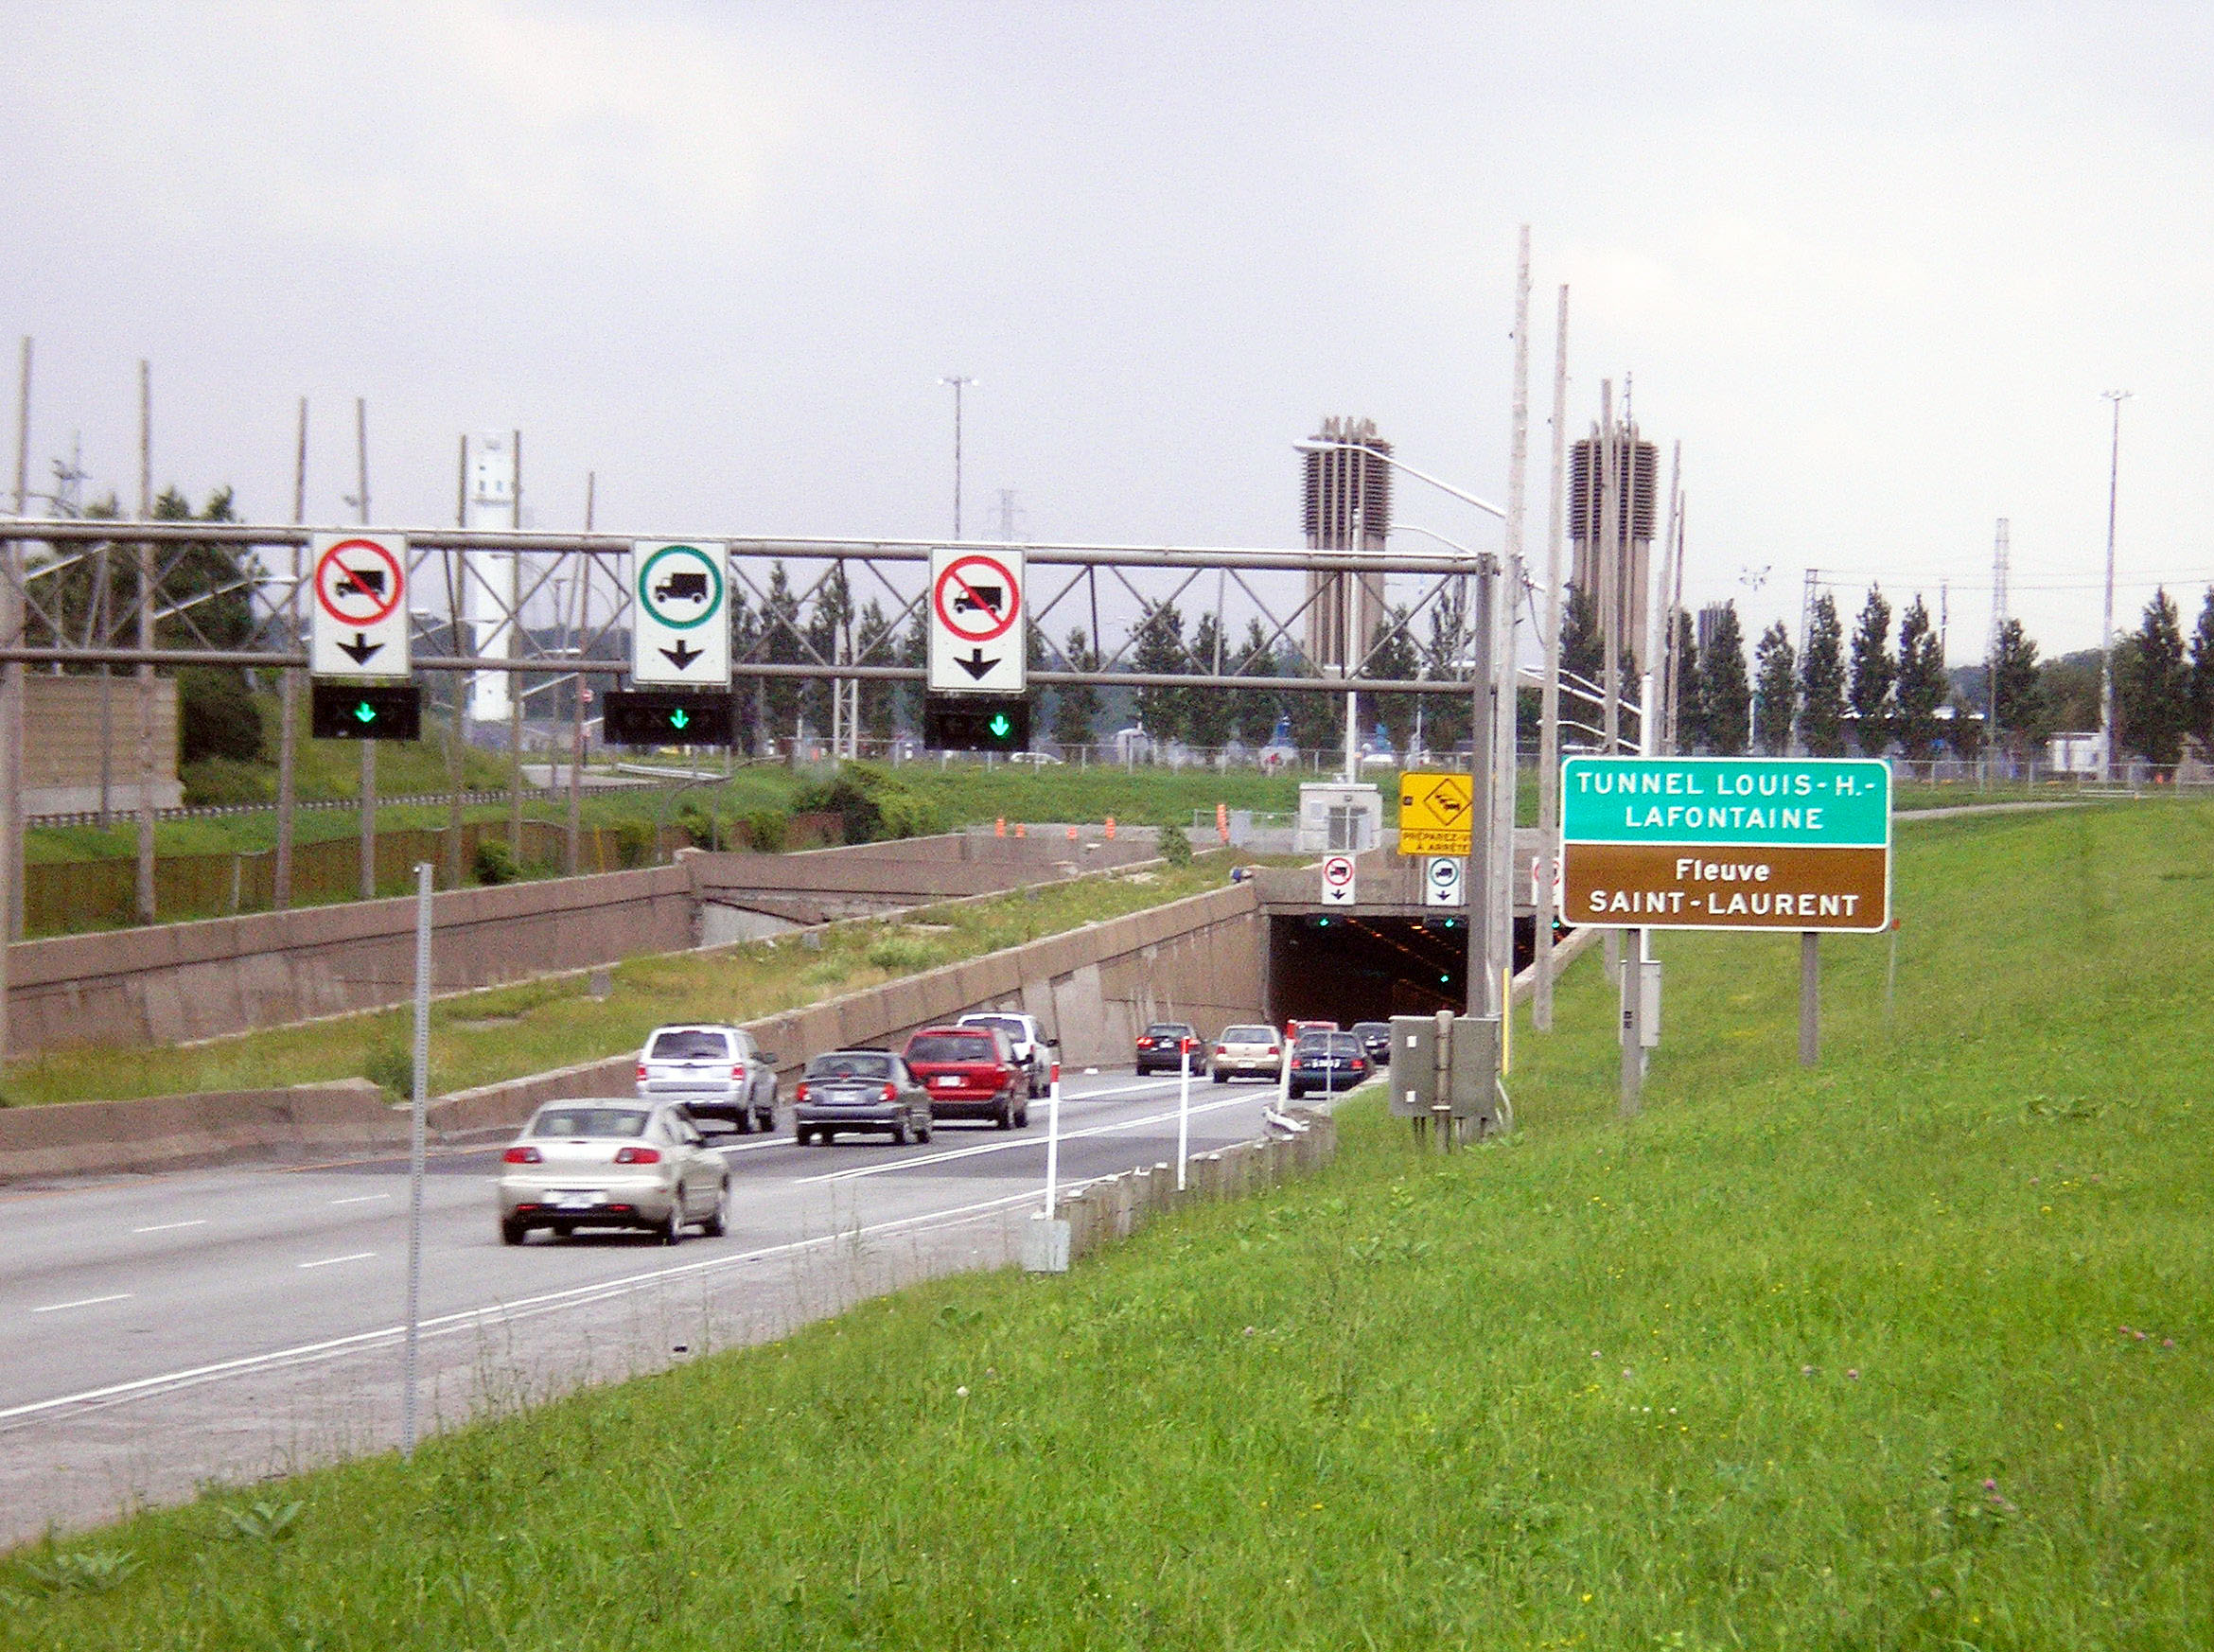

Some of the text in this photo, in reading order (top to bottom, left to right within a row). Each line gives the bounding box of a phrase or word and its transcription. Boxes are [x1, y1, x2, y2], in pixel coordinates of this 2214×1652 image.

[1576, 771, 1704, 796] TUNNEL
[1625, 806, 1824, 830] LAFONTAINE
[1676, 858, 1771, 882] Fleuve
[1590, 890, 1859, 917] SAINT-LAURENT
